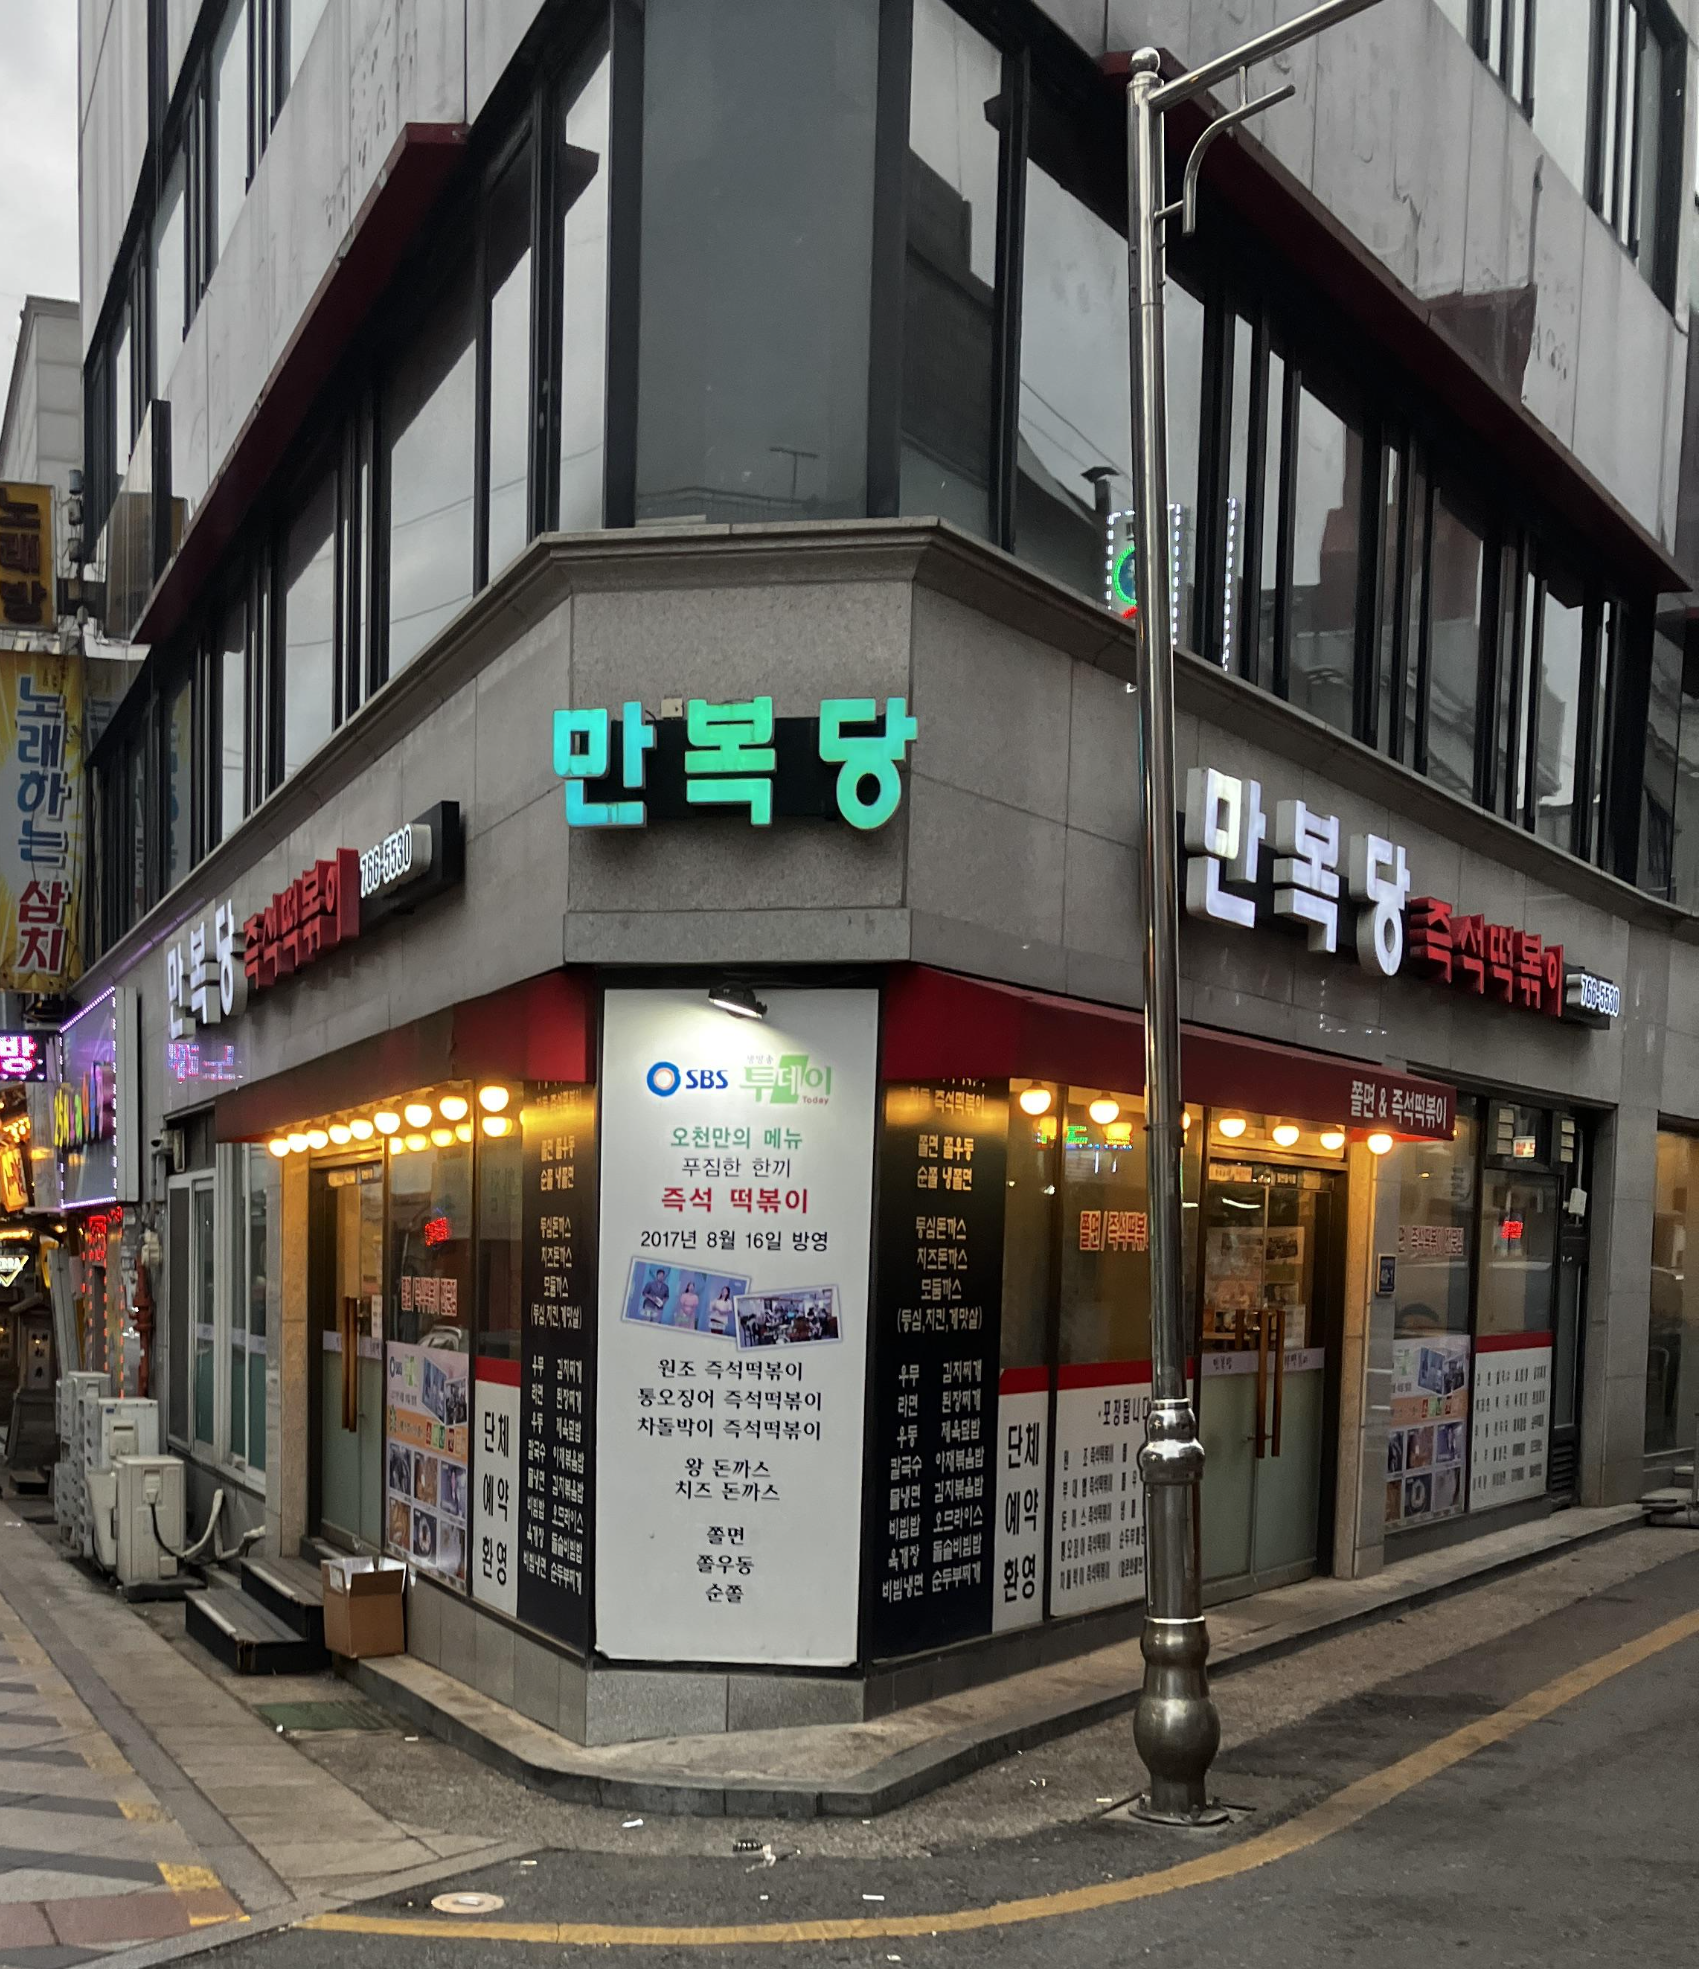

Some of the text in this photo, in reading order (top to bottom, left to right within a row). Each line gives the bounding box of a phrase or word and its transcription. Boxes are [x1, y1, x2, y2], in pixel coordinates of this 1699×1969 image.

[553, 695, 918, 830] 만복당
[16, 674, 69, 977] 노래하는 삼치
[1188, 767, 1621, 1018] 만복당 즉석떡볶이 766-5530
[167, 823, 413, 1040] 만복당 즉석떡볶이 766-5530
[685, 1064, 831, 1103] SBS 투데이
[802, 1095, 830, 1106] Today
[1351, 1080, 1447, 1131] 쫄면 & 즉석떡볶이
[671, 1126, 803, 1150] 오천만의 메뉴
[918, 1134, 974, 1161] 쫄면 쫄우동
[682, 1157, 791, 1178] 푸짐한 한끼
[917, 1165, 972, 1191] 순쫄 냉쫄면
[661, 1187, 808, 1214] 즉석 떡볶이
[540, 1215, 572, 1240] 등심돈까스
[640, 1230, 828, 1252] 2017년 8월 16일 방영
[915, 1215, 967, 1240] 등심돈까스
[541, 1245, 573, 1269] 치즈돈까스
[916, 1246, 968, 1271] 치즈돈까스
[658, 1358, 803, 1381] 원조 즉석떡볶이
[898, 1358, 982, 1388] 우무 김치찌개
[638, 1387, 822, 1411] 통오징어 즉석떡볶이
[897, 1388, 981, 1418] 라면 된장찌개
[484, 1411, 509, 1459] 단체
[637, 1417, 821, 1441] 차돌박이 즉석떡볶이
[897, 1416, 981, 1449] 우동 제육덮밥
[1008, 1422, 1040, 1470] 단체
[685, 1457, 771, 1479] 왕 돈까스
[890, 1445, 984, 1481] 칼국수 야채볶음밥
[482, 1472, 509, 1523] 예약
[675, 1480, 780, 1502] 치즈 돈까스
[889, 1474, 984, 1511] 물냉면 김치볶음밥
[1005, 1488, 1039, 1536] 예약
[707, 1526, 744, 1545] 쫄면
[888, 1513, 921, 1542] 비빔밥
[482, 1535, 507, 1587] 환영
[932, 1531, 982, 1563] 돌솥비빔밥
[696, 1554, 754, 1575] 쫄우동
[1004, 1553, 1036, 1603] 환영
[705, 1583, 744, 1603] 순쫄
[882, 1560, 982, 1603] 비빔냉면 순두부찌개
